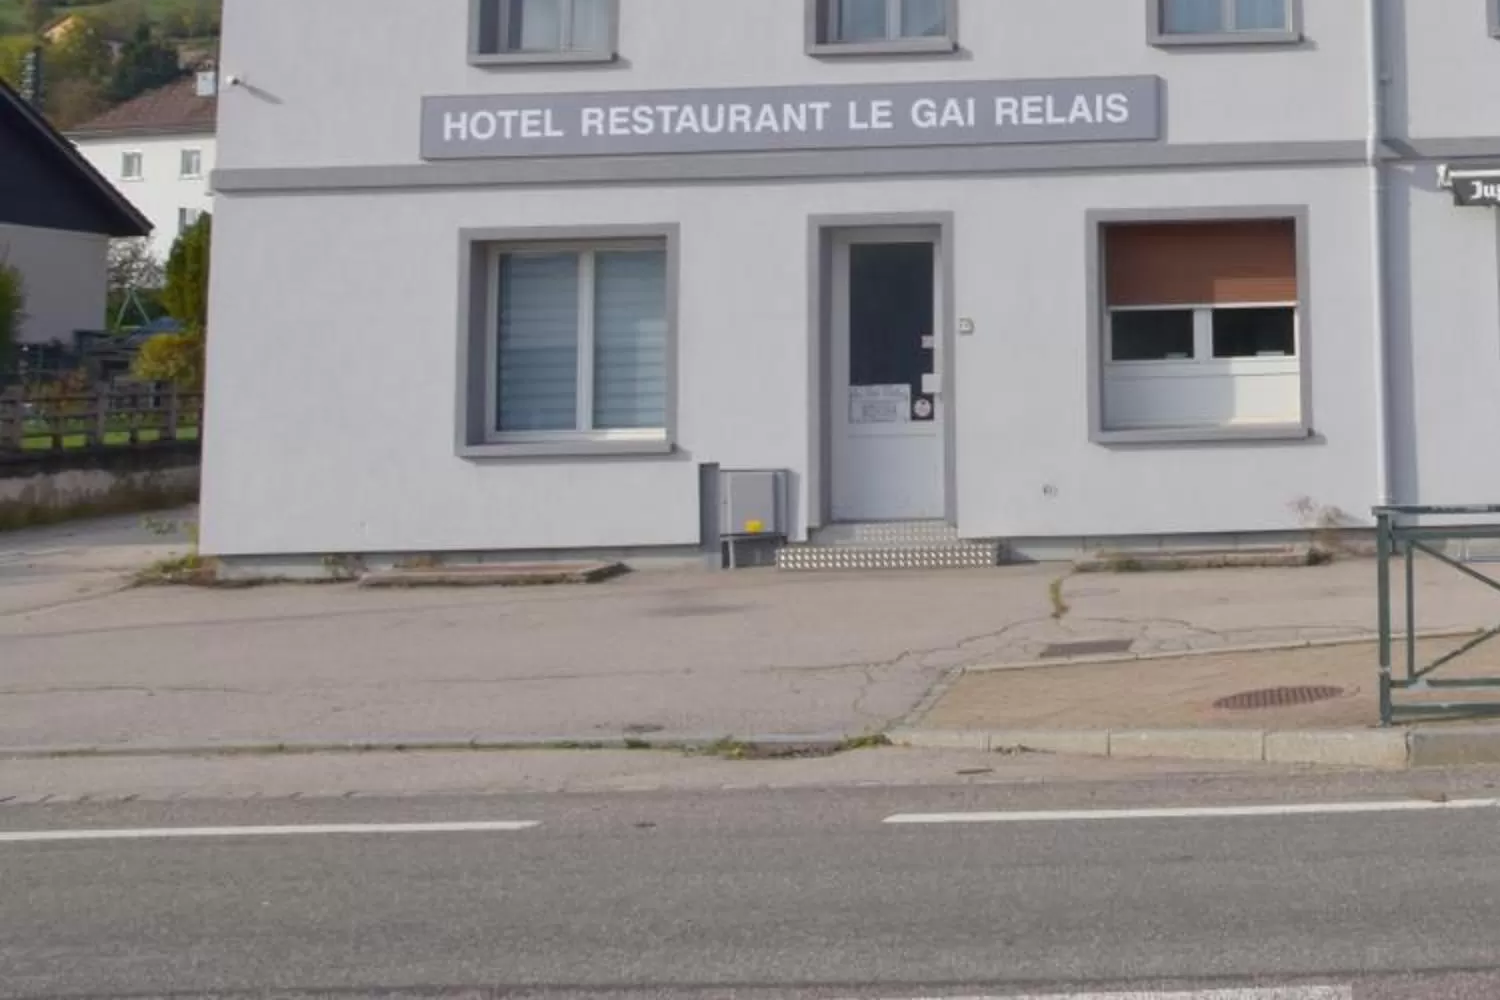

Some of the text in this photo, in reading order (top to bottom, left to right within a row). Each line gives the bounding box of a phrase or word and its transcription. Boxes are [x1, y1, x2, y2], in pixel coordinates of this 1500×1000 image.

[443, 93, 1130, 141] HOTEL RESTAURANT LE GAI RELAIS
